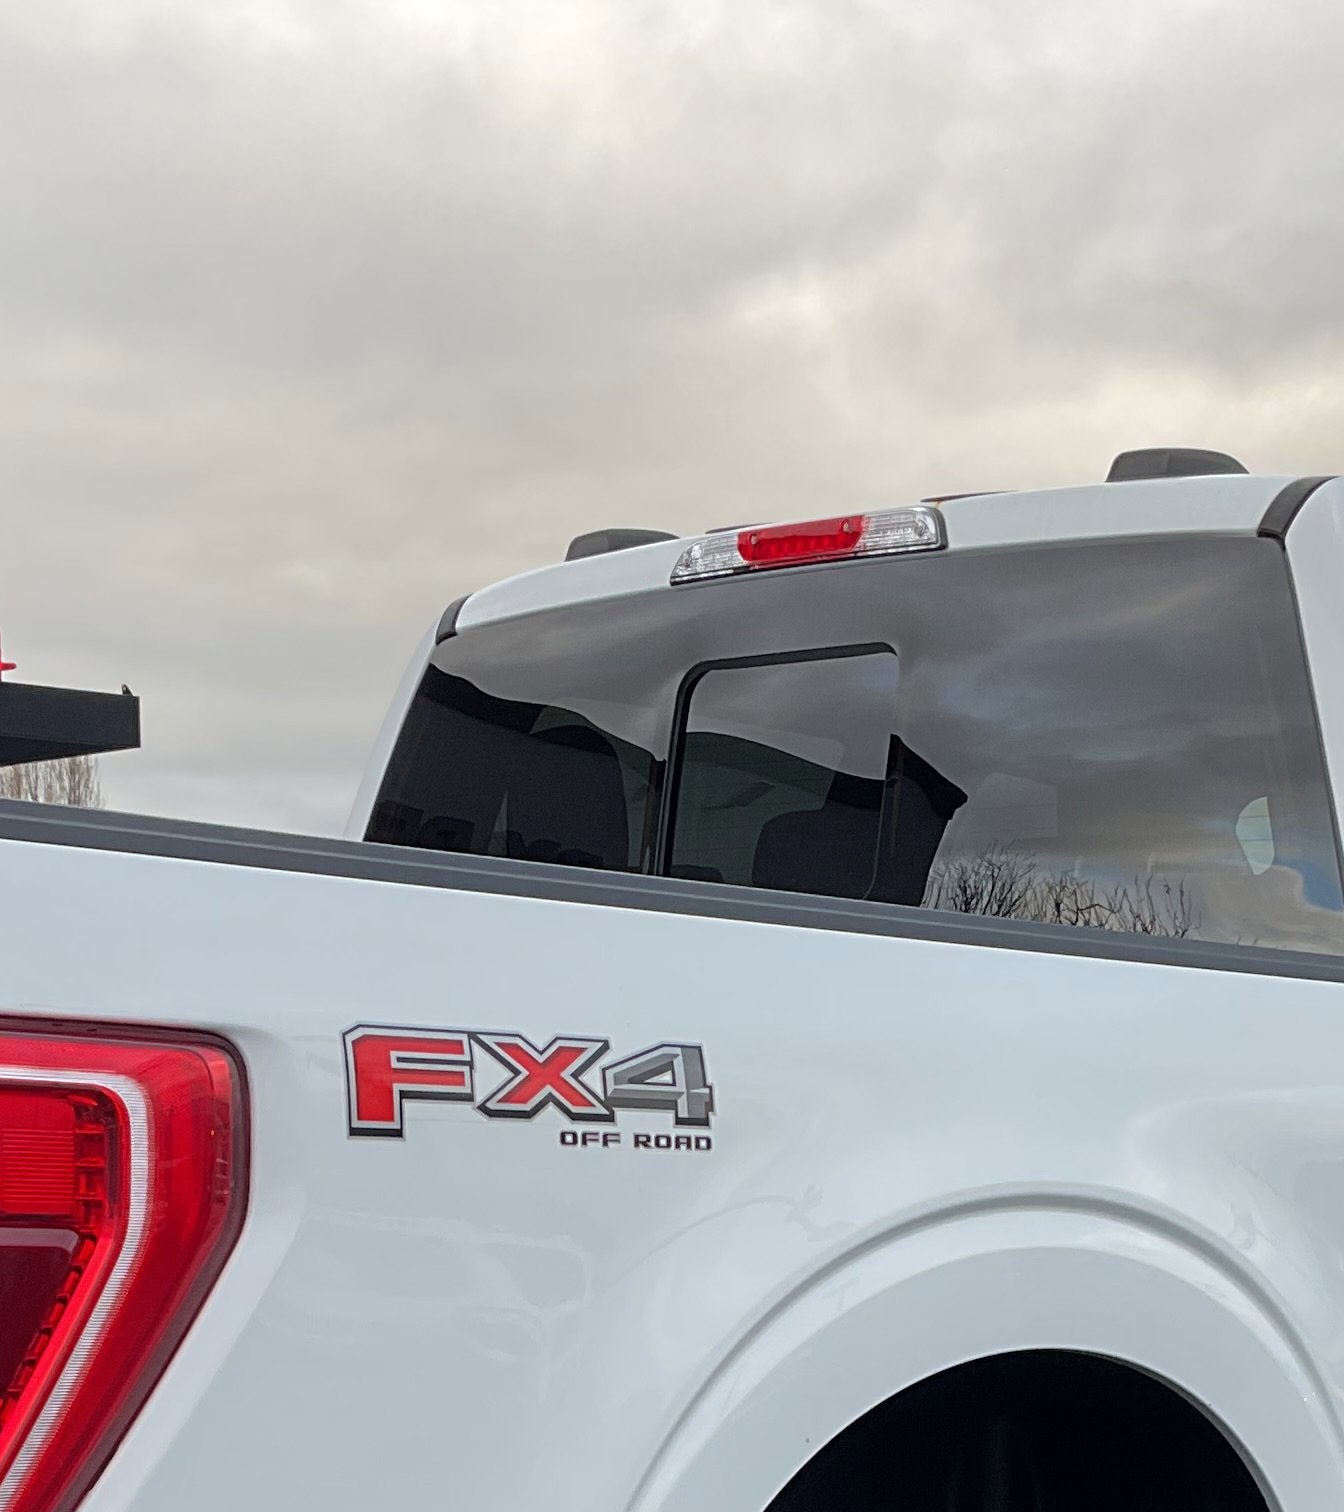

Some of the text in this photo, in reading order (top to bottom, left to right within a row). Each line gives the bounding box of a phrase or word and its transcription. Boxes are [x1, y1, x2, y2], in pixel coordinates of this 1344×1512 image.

[342, 1024, 716, 1139] FX4
[560, 1130, 713, 1152] OFF ROAD
